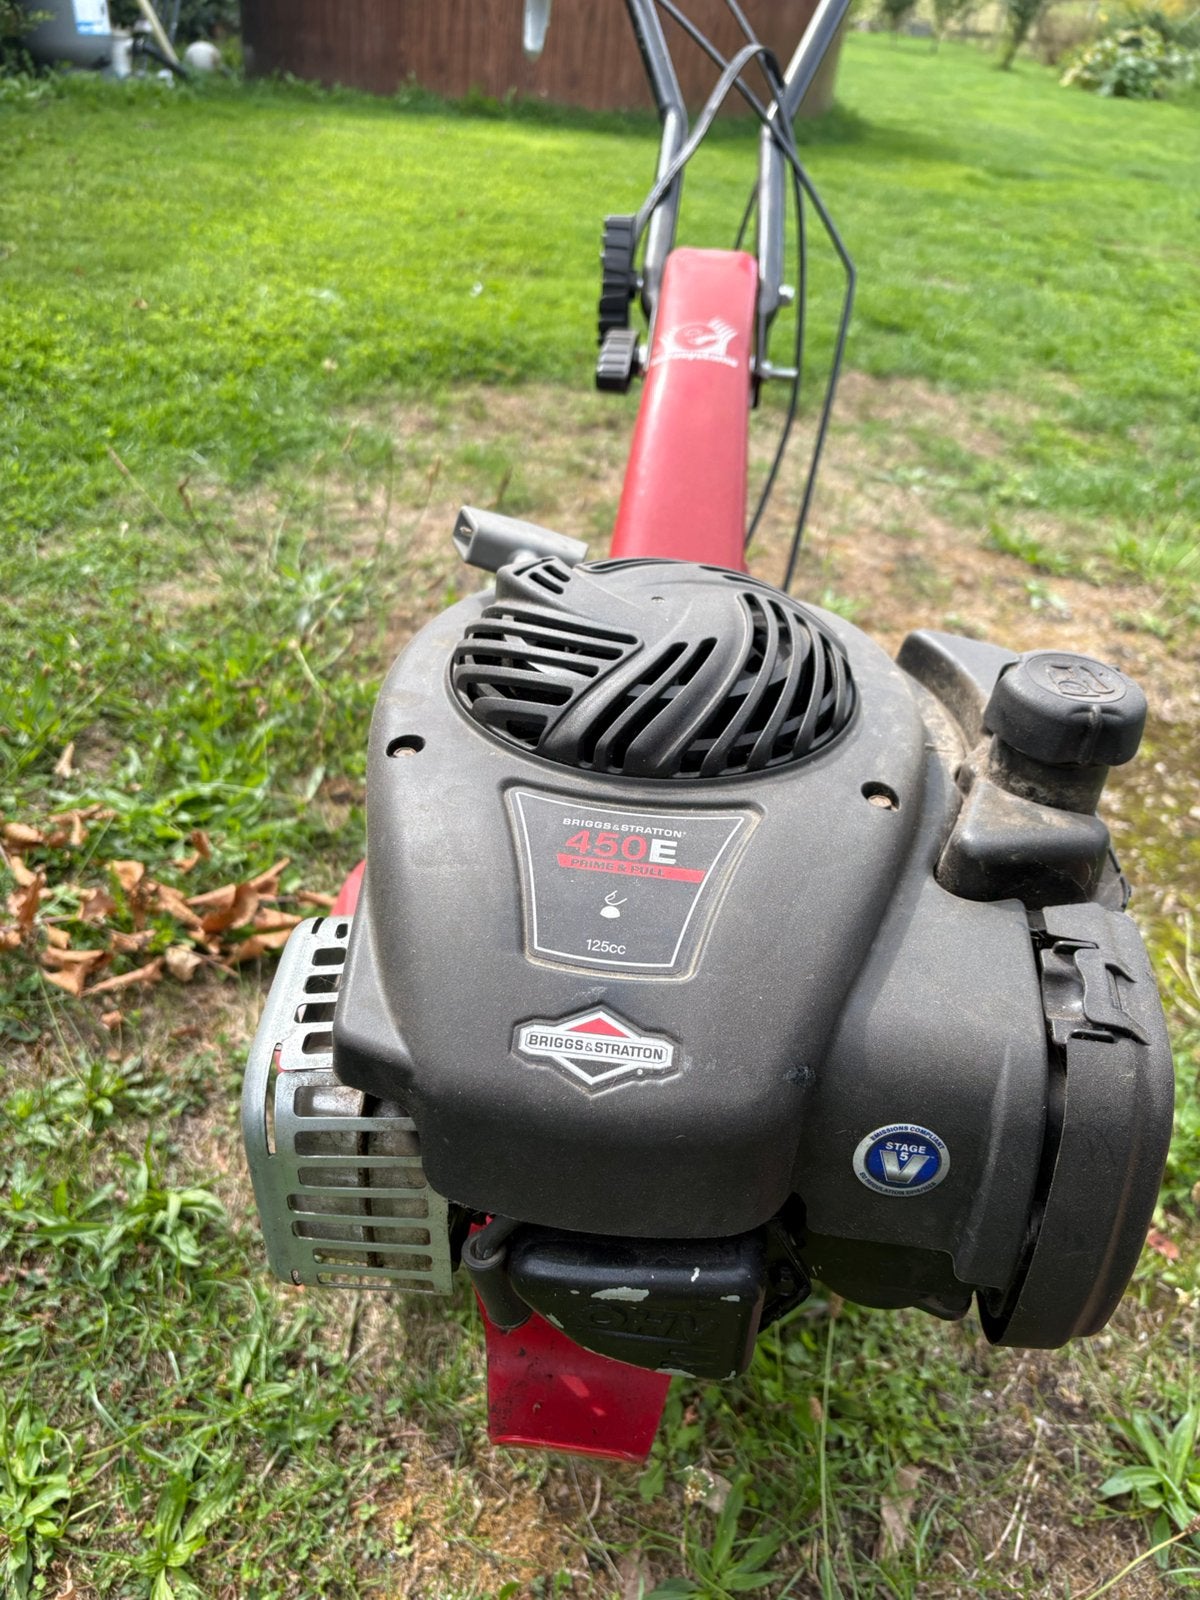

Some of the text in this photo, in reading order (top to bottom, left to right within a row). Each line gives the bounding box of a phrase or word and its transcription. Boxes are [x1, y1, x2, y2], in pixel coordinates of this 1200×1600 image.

[565, 829, 678, 865] 450E
[570, 857, 665, 877] PRIME & PULL
[586, 938, 627, 955] 125cc
[870, 1126, 945, 1149] EMISSIONS COMPLIANT
[885, 1141, 927, 1154] STAGE
[899, 1152, 909, 1161] 5
